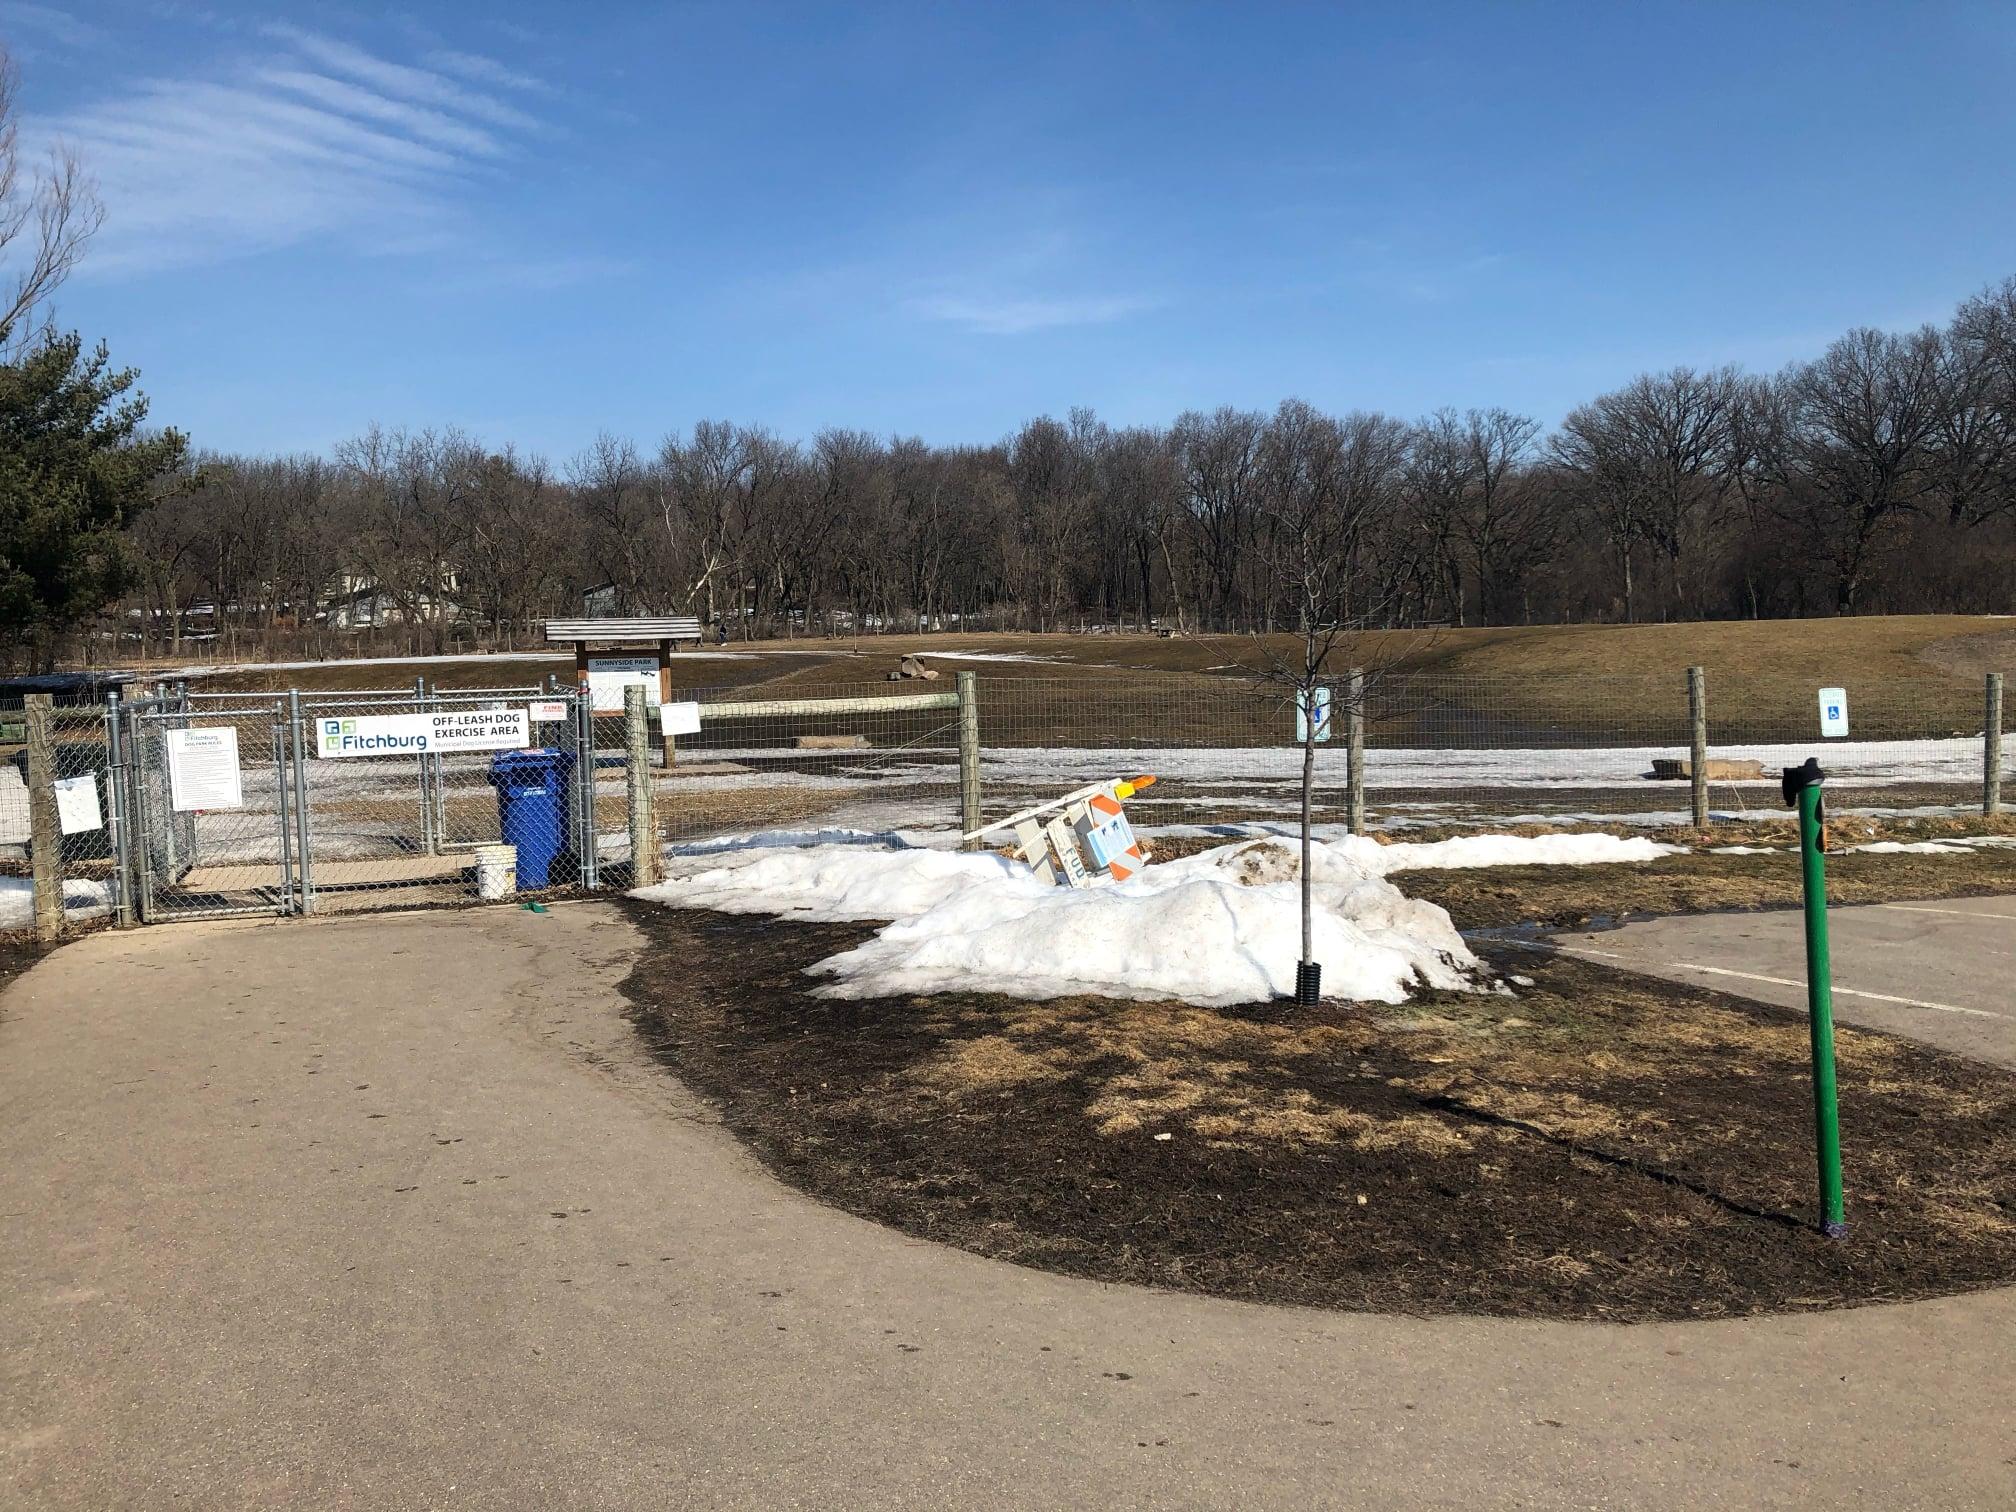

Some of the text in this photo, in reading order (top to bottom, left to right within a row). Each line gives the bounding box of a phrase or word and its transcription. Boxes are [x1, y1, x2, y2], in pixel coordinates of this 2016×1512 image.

[595, 658, 652, 667] SUNNYSIDE PARK
[432, 713, 520, 727] OFF-LEASH DOG
[434, 725, 520, 739] EXERCISE AREA
[343, 734, 427, 751] Fitchburg
[462, 740, 475, 748] Dog
